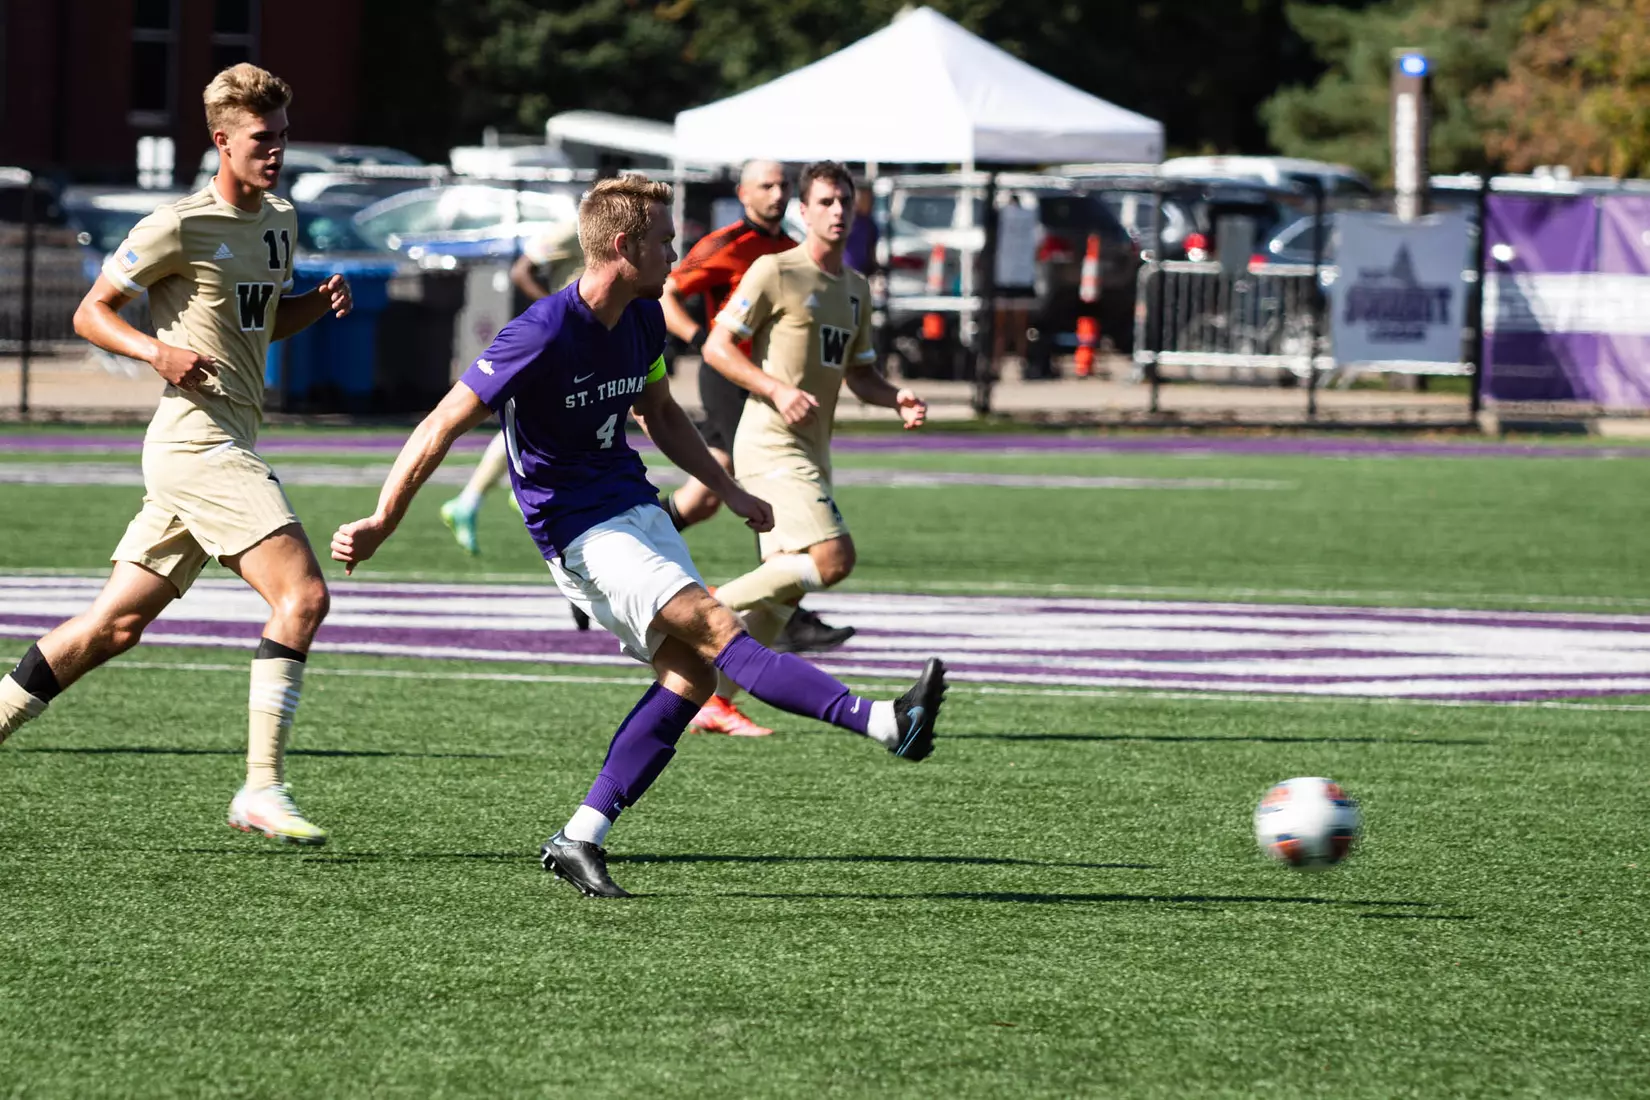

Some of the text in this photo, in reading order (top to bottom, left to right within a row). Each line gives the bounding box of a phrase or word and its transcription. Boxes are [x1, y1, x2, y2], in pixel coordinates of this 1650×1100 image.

[263, 228, 290, 271] 11
[236, 282, 275, 331] W
[820, 324, 853, 369] W
[565, 391, 594, 408] ST.
[596, 413, 618, 449] 4
